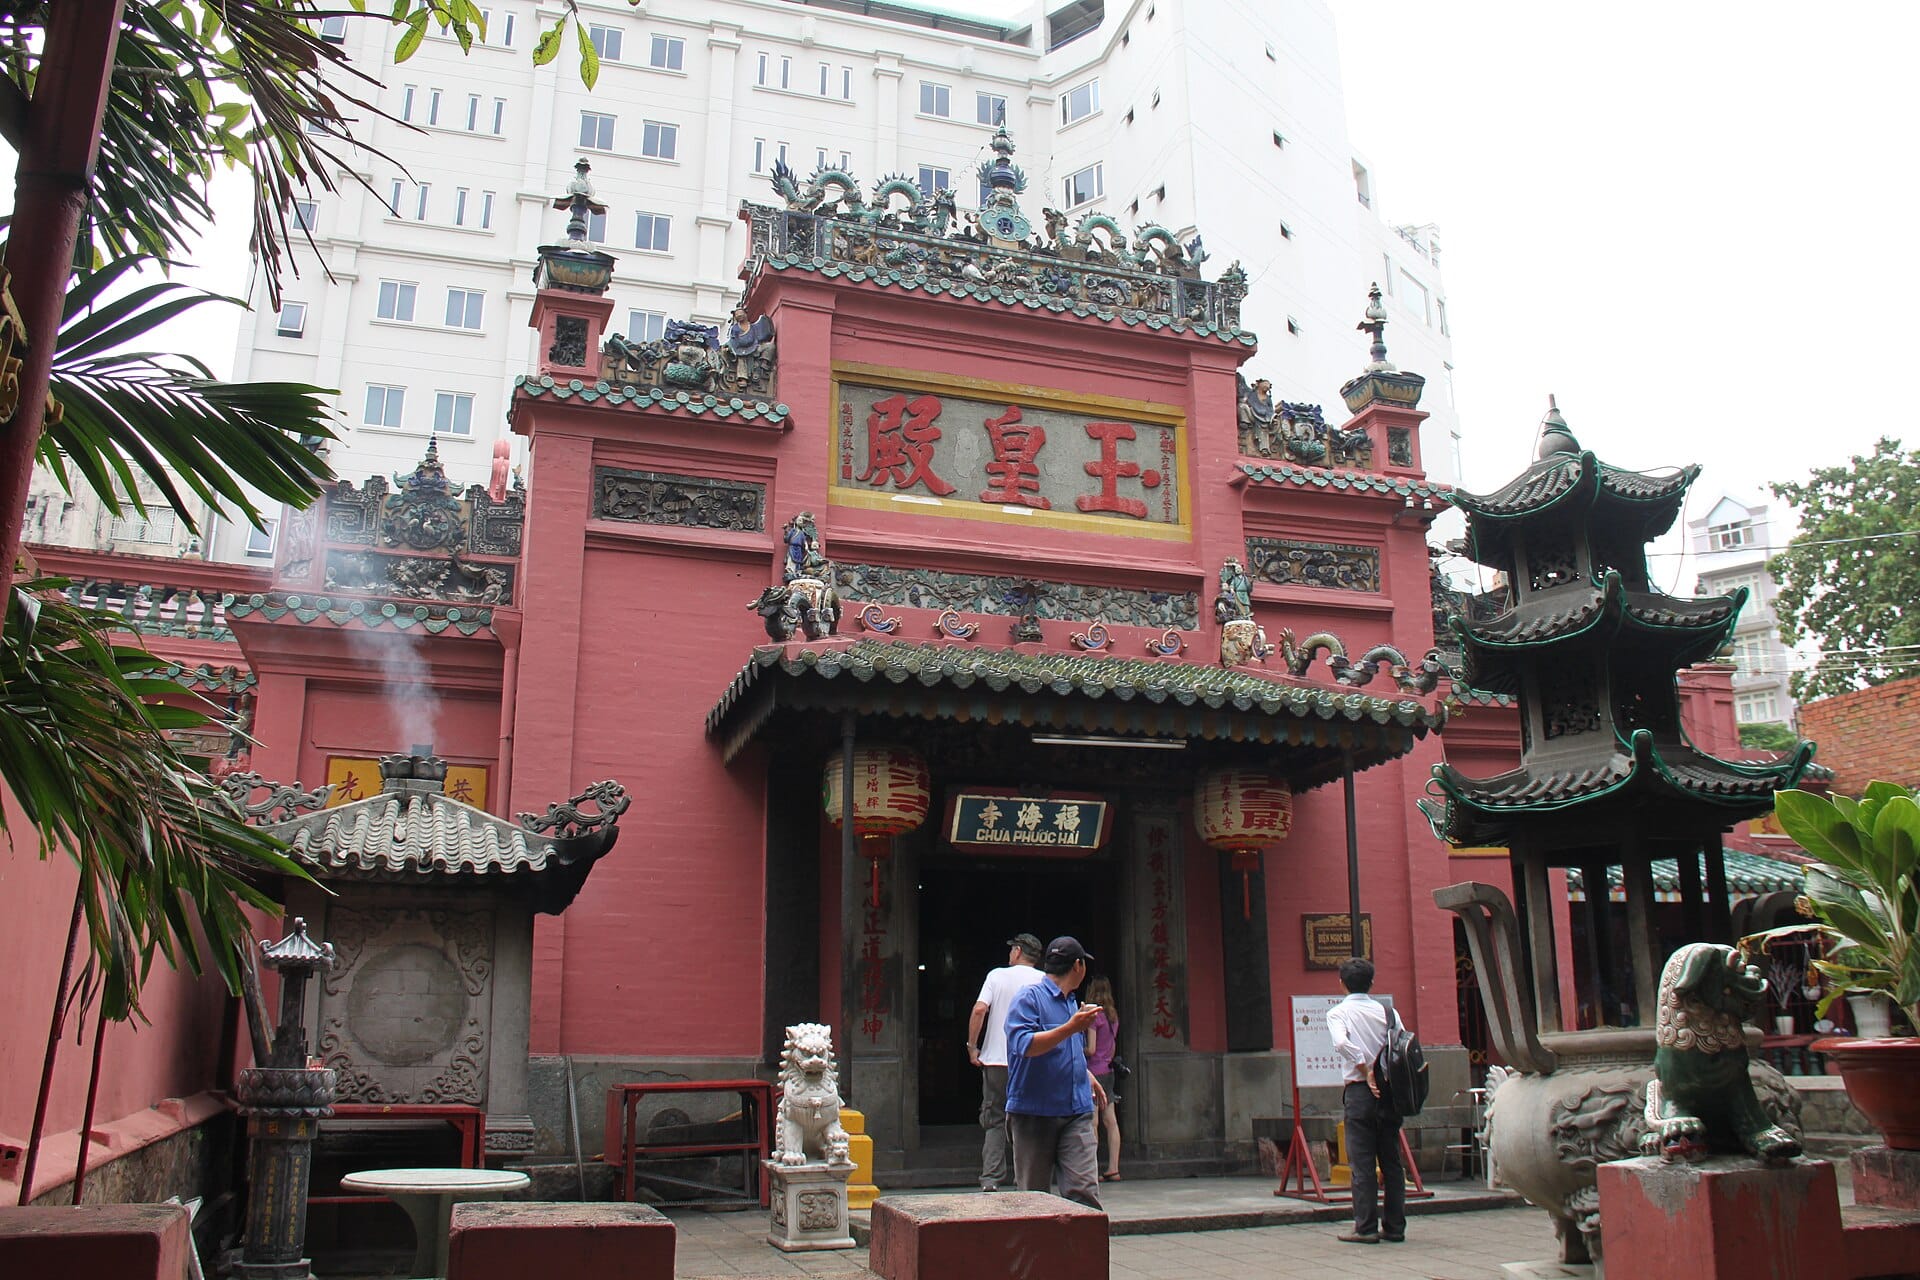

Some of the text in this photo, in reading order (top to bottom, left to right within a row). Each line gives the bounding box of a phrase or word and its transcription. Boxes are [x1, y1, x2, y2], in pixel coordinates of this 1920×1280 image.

[855, 394, 1161, 519] 玉皇殿
[978, 801, 1081, 832] 福海寺
